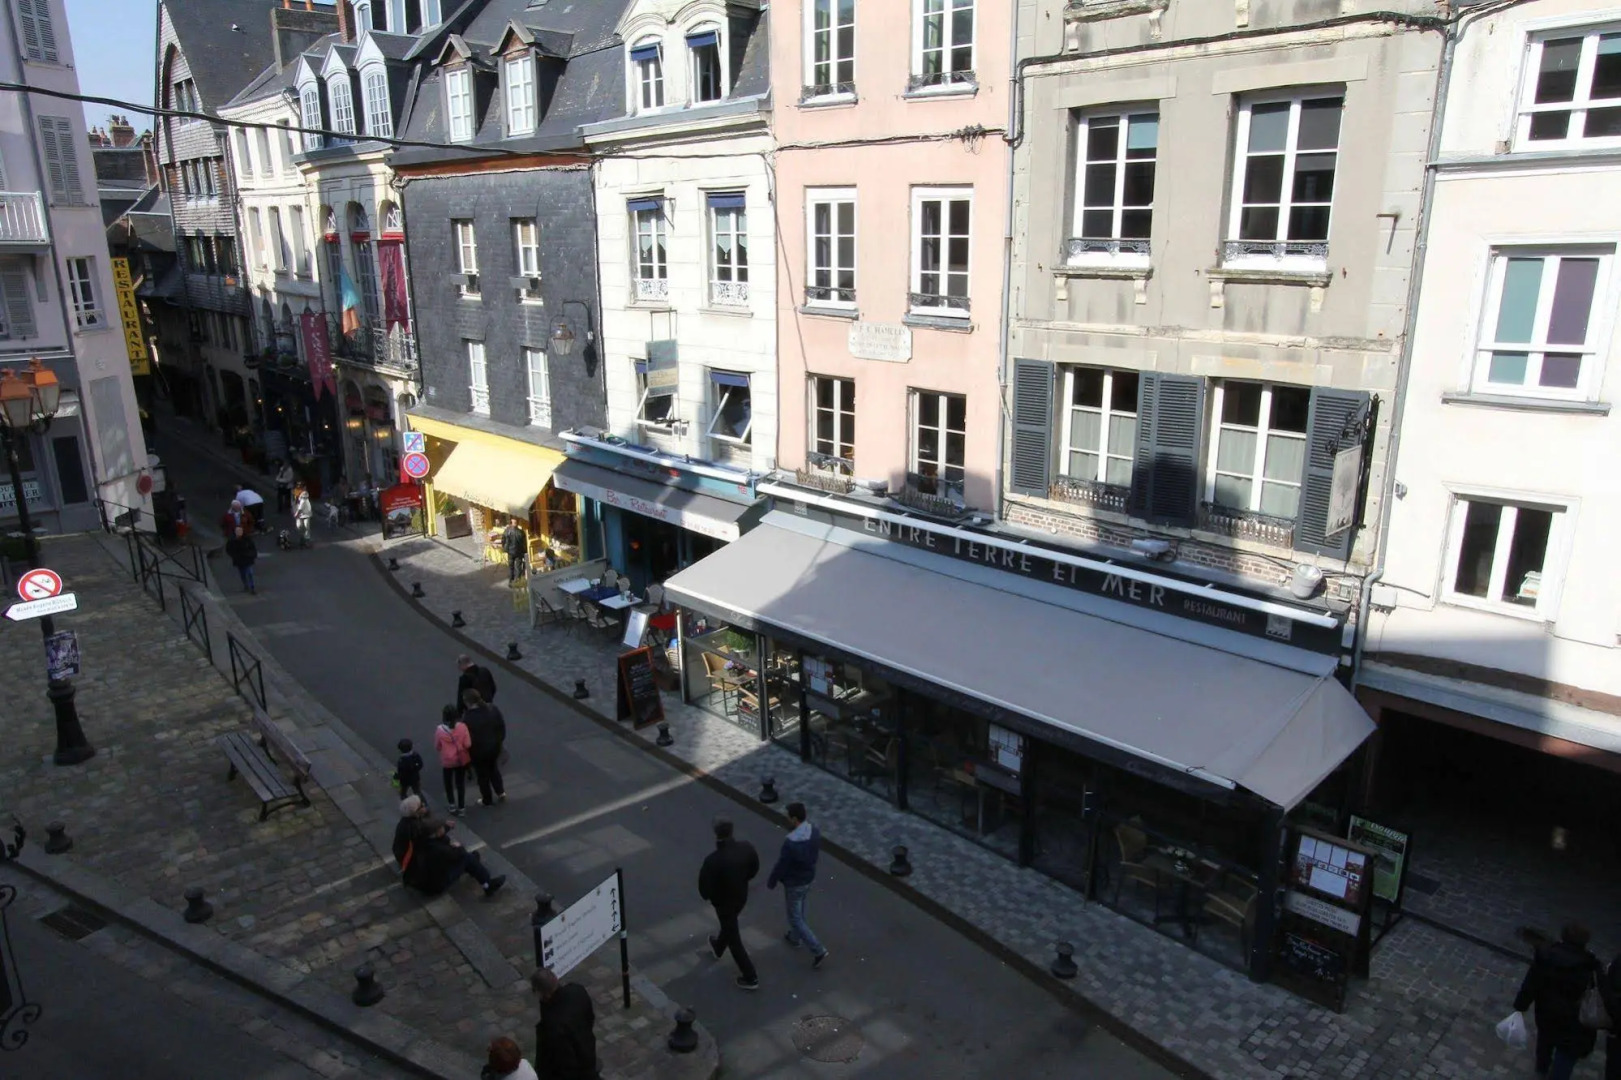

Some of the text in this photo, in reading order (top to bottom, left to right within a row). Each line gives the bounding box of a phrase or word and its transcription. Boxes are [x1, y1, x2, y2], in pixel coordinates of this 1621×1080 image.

[114, 260, 143, 358] RESTAURANT
[630, 498, 668, 519] Restaurant
[864, 516, 1165, 607] ENTRE TERRE ET MER
[1183, 598, 1246, 625] RESTAURANT
